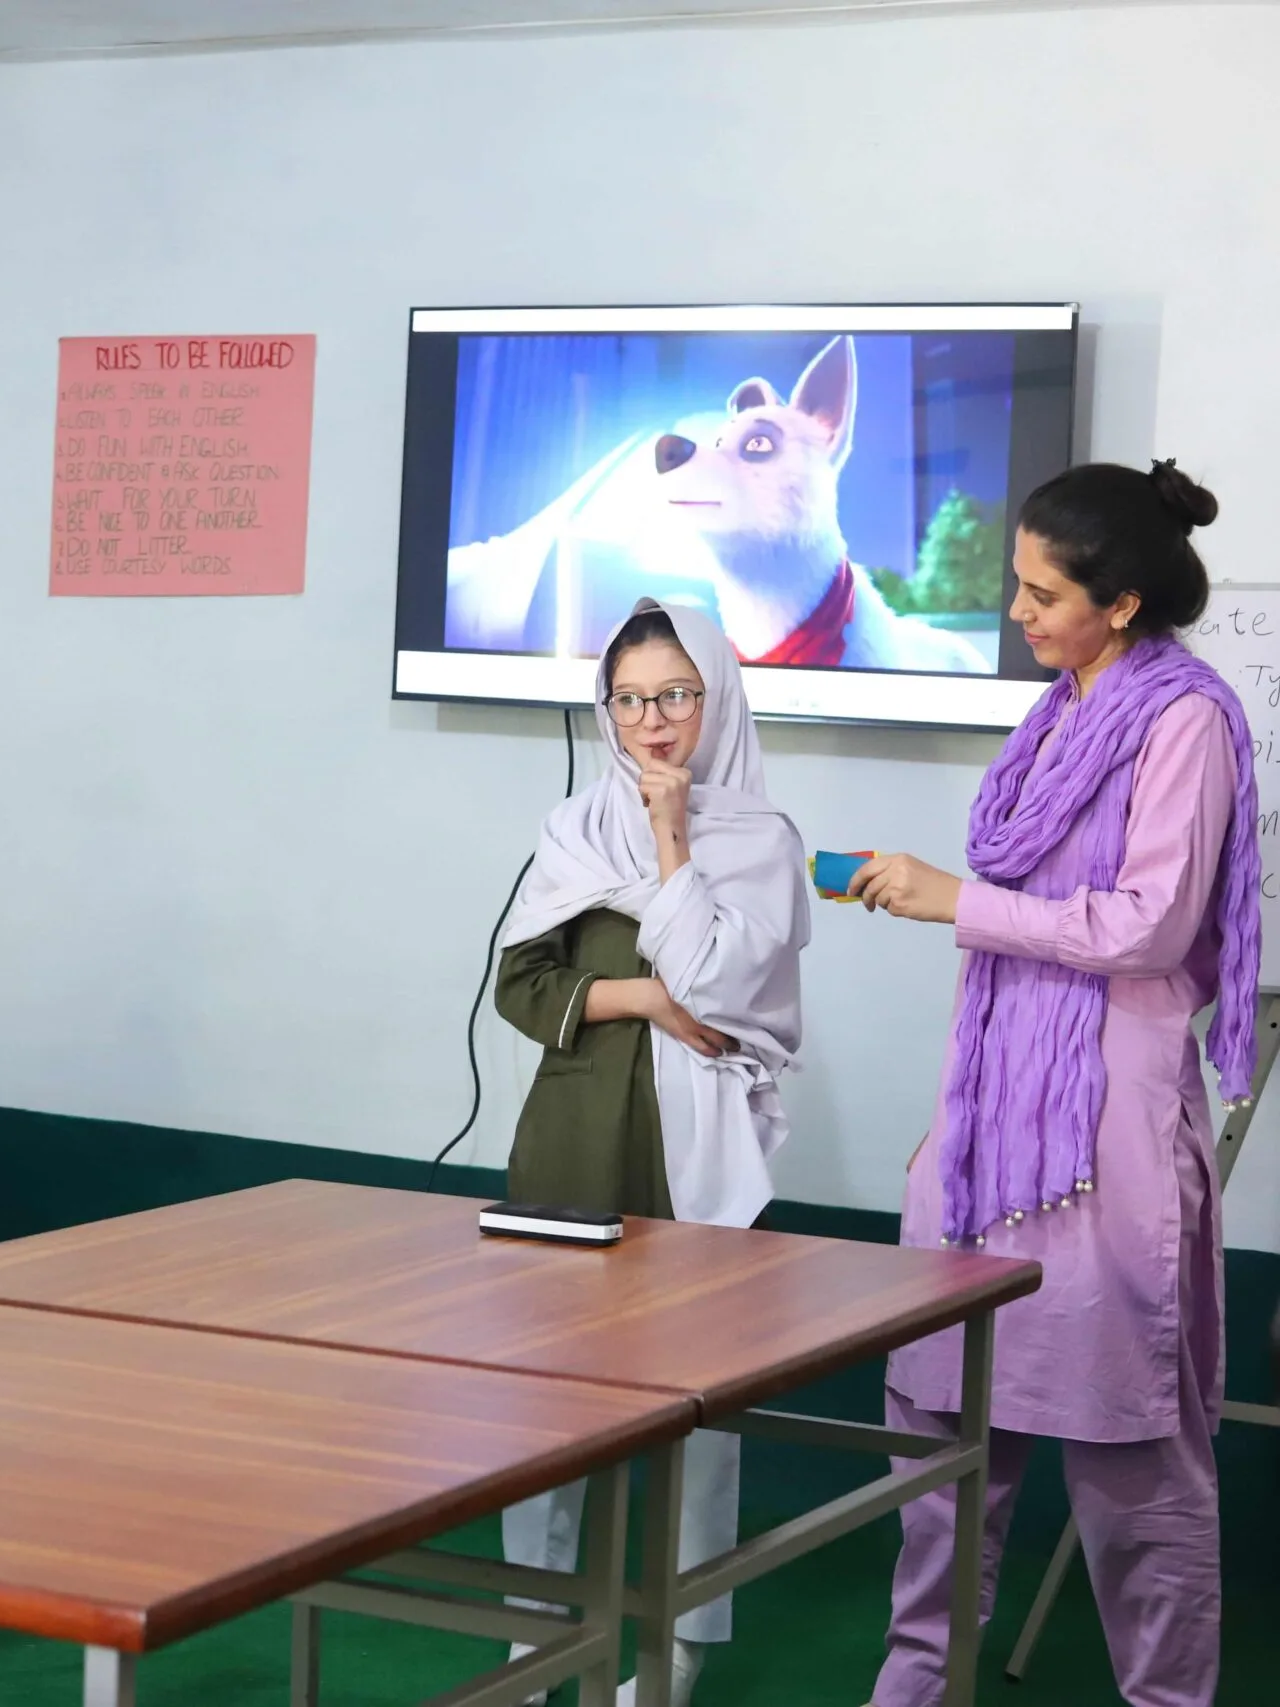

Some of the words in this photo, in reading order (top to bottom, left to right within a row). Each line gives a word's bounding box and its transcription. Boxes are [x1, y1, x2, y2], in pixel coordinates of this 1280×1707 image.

[96, 343, 141, 370] RULES
[155, 342, 180, 368] TO
[188, 341, 209, 369] BE
[219, 341, 294, 369] FOLLOWED
[201, 380, 261, 399] ENGLISH
[67, 409, 106, 429] LISTEN
[148, 407, 181, 428] EACH
[192, 406, 246, 428] OTHER
[68, 436, 86, 458] DO
[97, 434, 127, 458] FUN
[139, 434, 174, 458] WITH
[179, 434, 249, 458] ENGLISH
[65, 461, 85, 482] BE
[86, 460, 156, 482] CONFIDENT
[173, 460, 200, 482] ASK
[209, 460, 279, 482] QUESTION
[67, 489, 104, 510] WAIT
[122, 486, 151, 510] FOR
[159, 486, 199, 510] YOUR
[207, 486, 256, 509] TURN
[66, 510, 87, 533] BE
[98, 511, 125, 532] NICE
[133, 510, 150, 532] TO
[159, 509, 188, 531] ONE
[195, 509, 264, 531] ANOTHER
[66, 536, 90, 558] DO
[96, 537, 123, 557] NOT
[137, 534, 192, 556] LITTER
[66, 558, 92, 575] USE
[180, 555, 232, 575] WORDS
